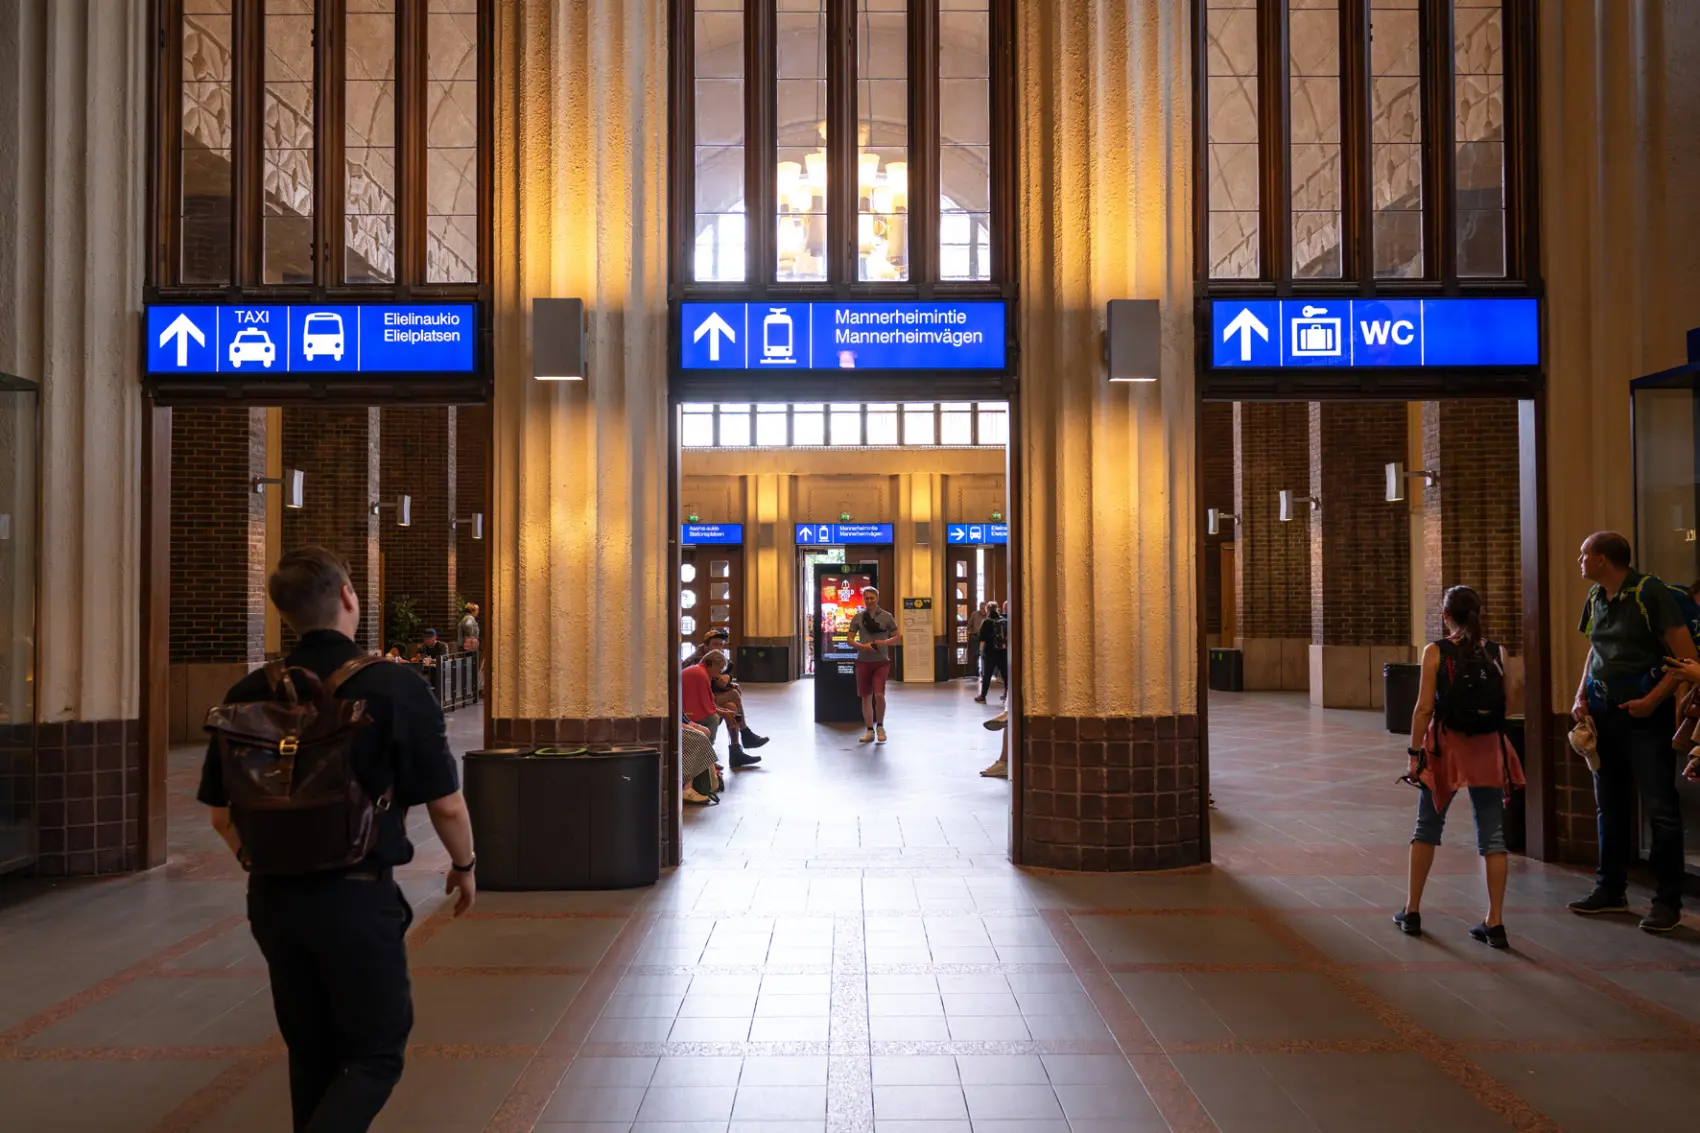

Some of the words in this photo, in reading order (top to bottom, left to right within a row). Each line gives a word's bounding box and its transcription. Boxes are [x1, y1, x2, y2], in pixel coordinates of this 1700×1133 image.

[234, 310, 270, 324] TAXI
[384, 312, 461, 326] Elielinaukio
[835, 309, 967, 325] Mannerheimintie
[384, 329, 461, 345] Elielplatsen
[835, 328, 983, 347] Mannerheimvägen
[1360, 320, 1415, 345] WC
